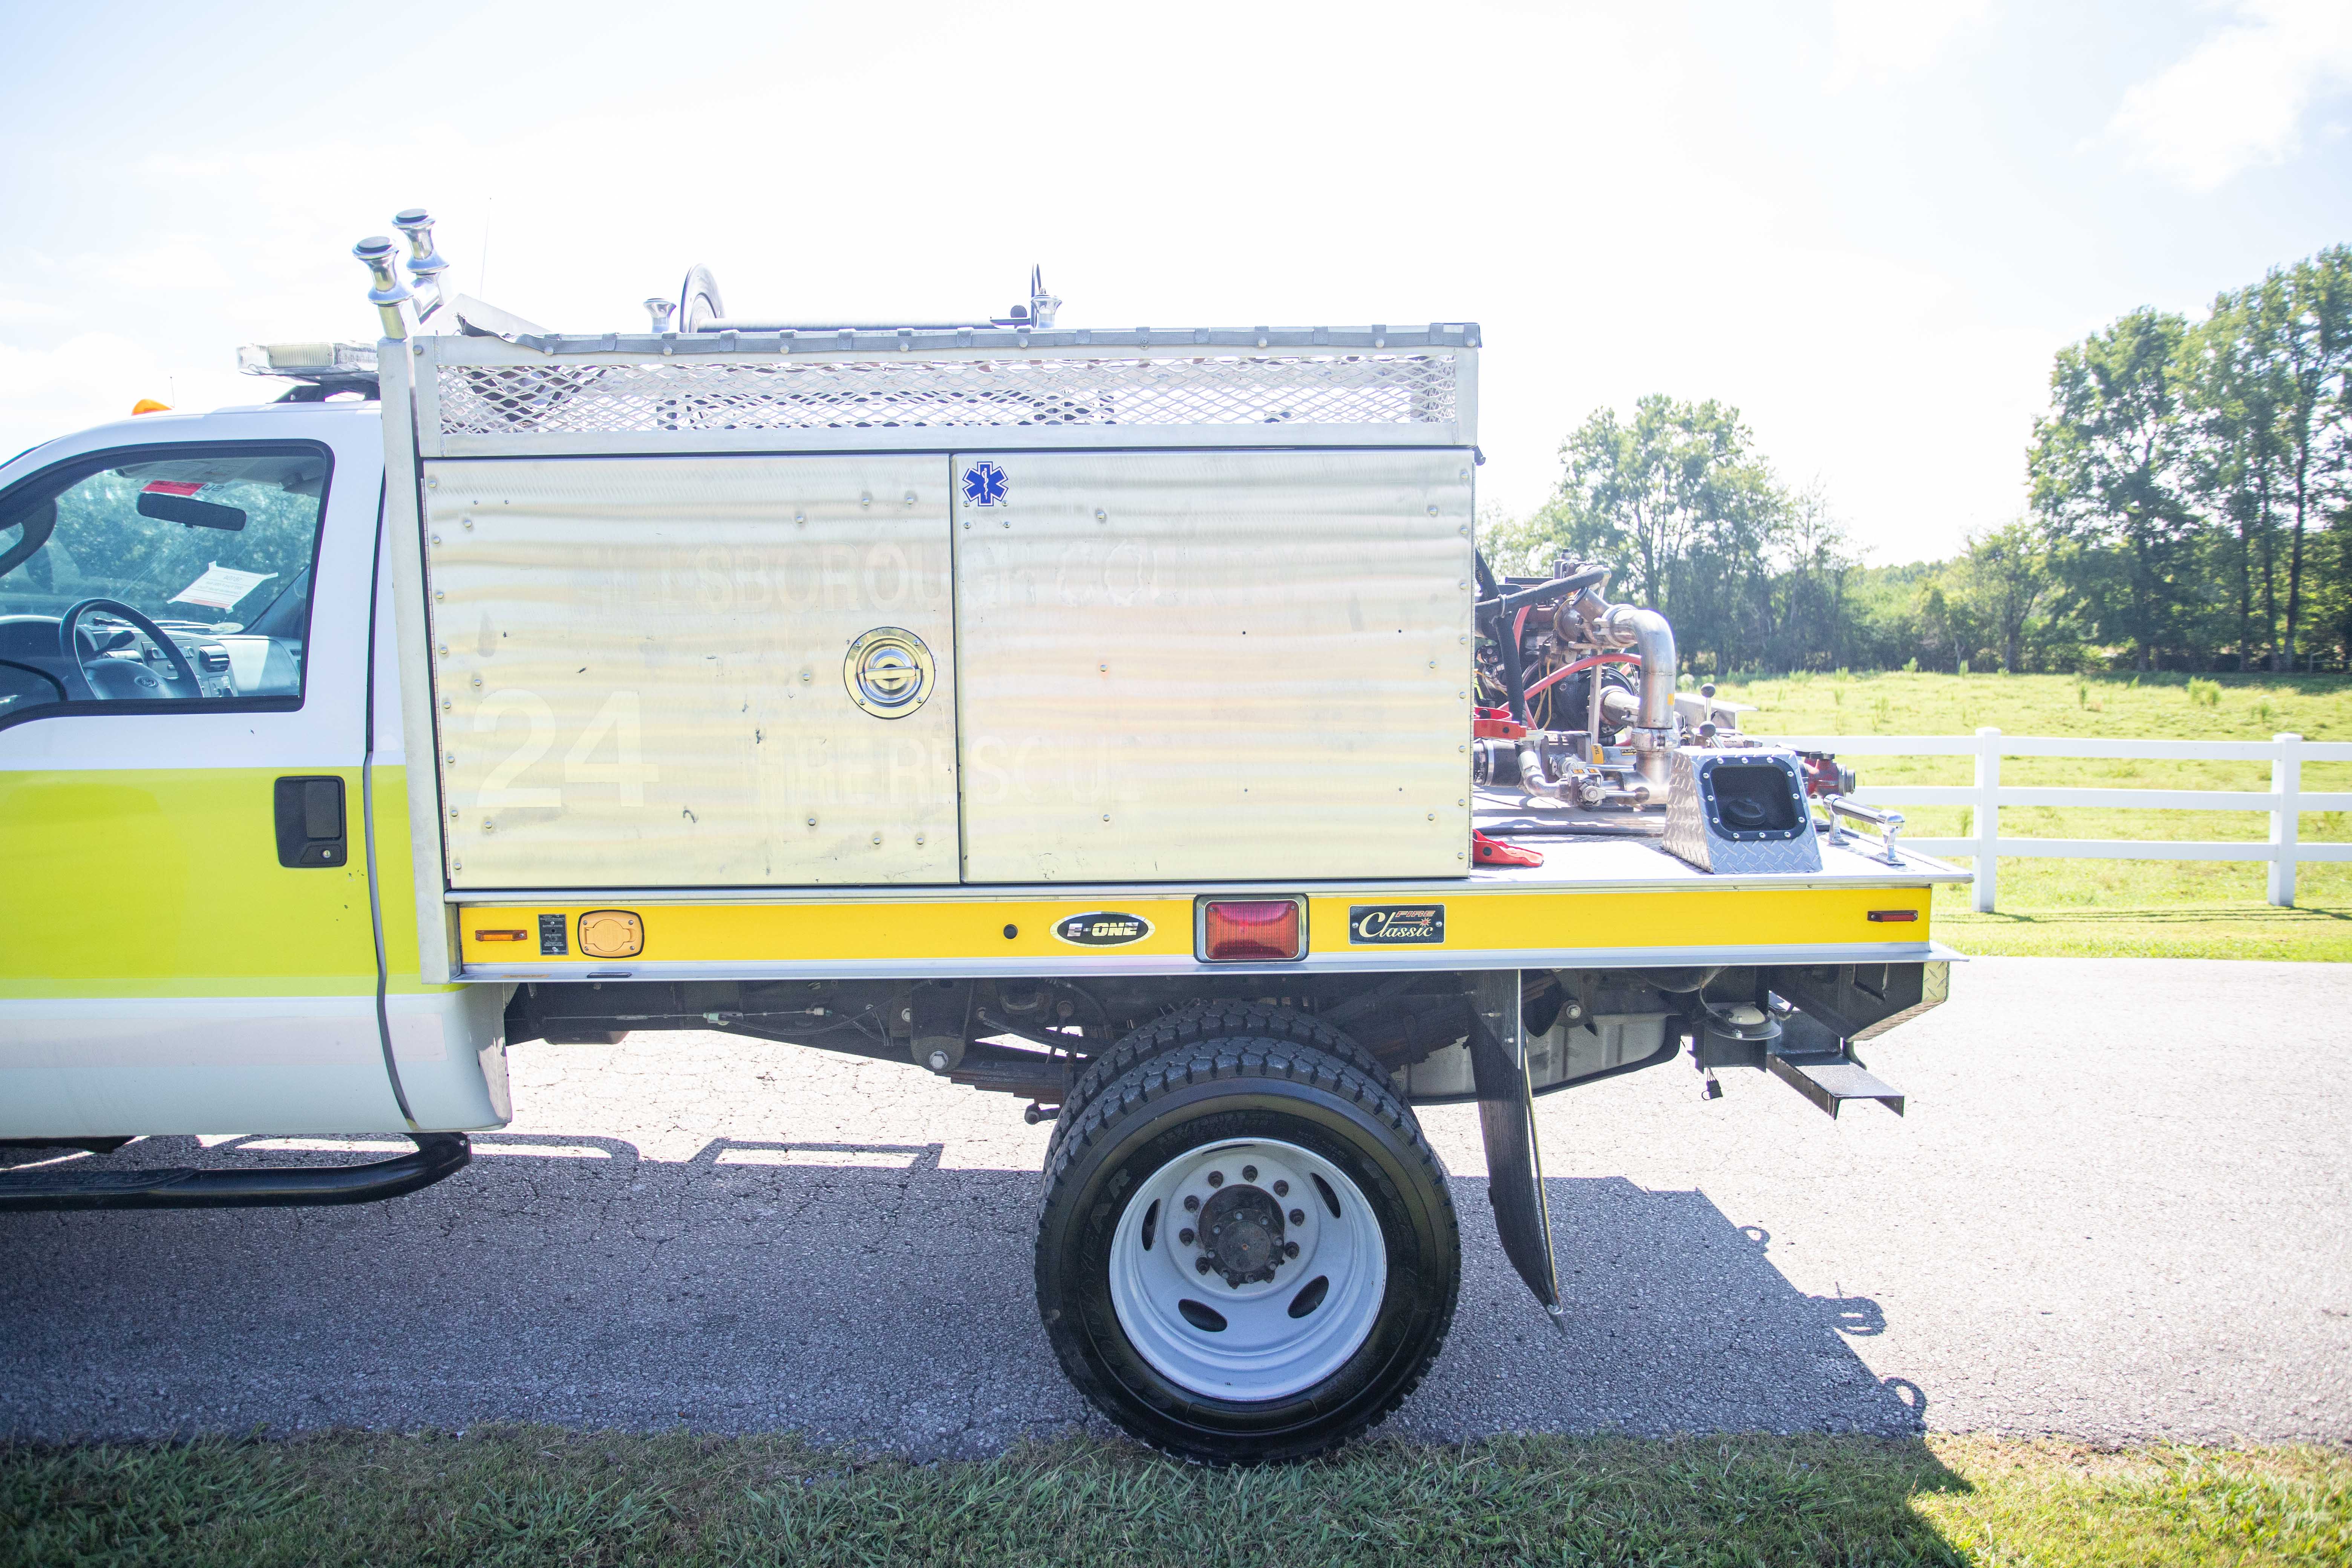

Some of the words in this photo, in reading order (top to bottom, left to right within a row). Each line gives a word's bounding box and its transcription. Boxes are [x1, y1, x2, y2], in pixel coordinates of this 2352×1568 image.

[474, 688, 659, 807] 24
[1067, 922, 1139, 937] E-ONE
[1359, 912, 1433, 937] Classic
